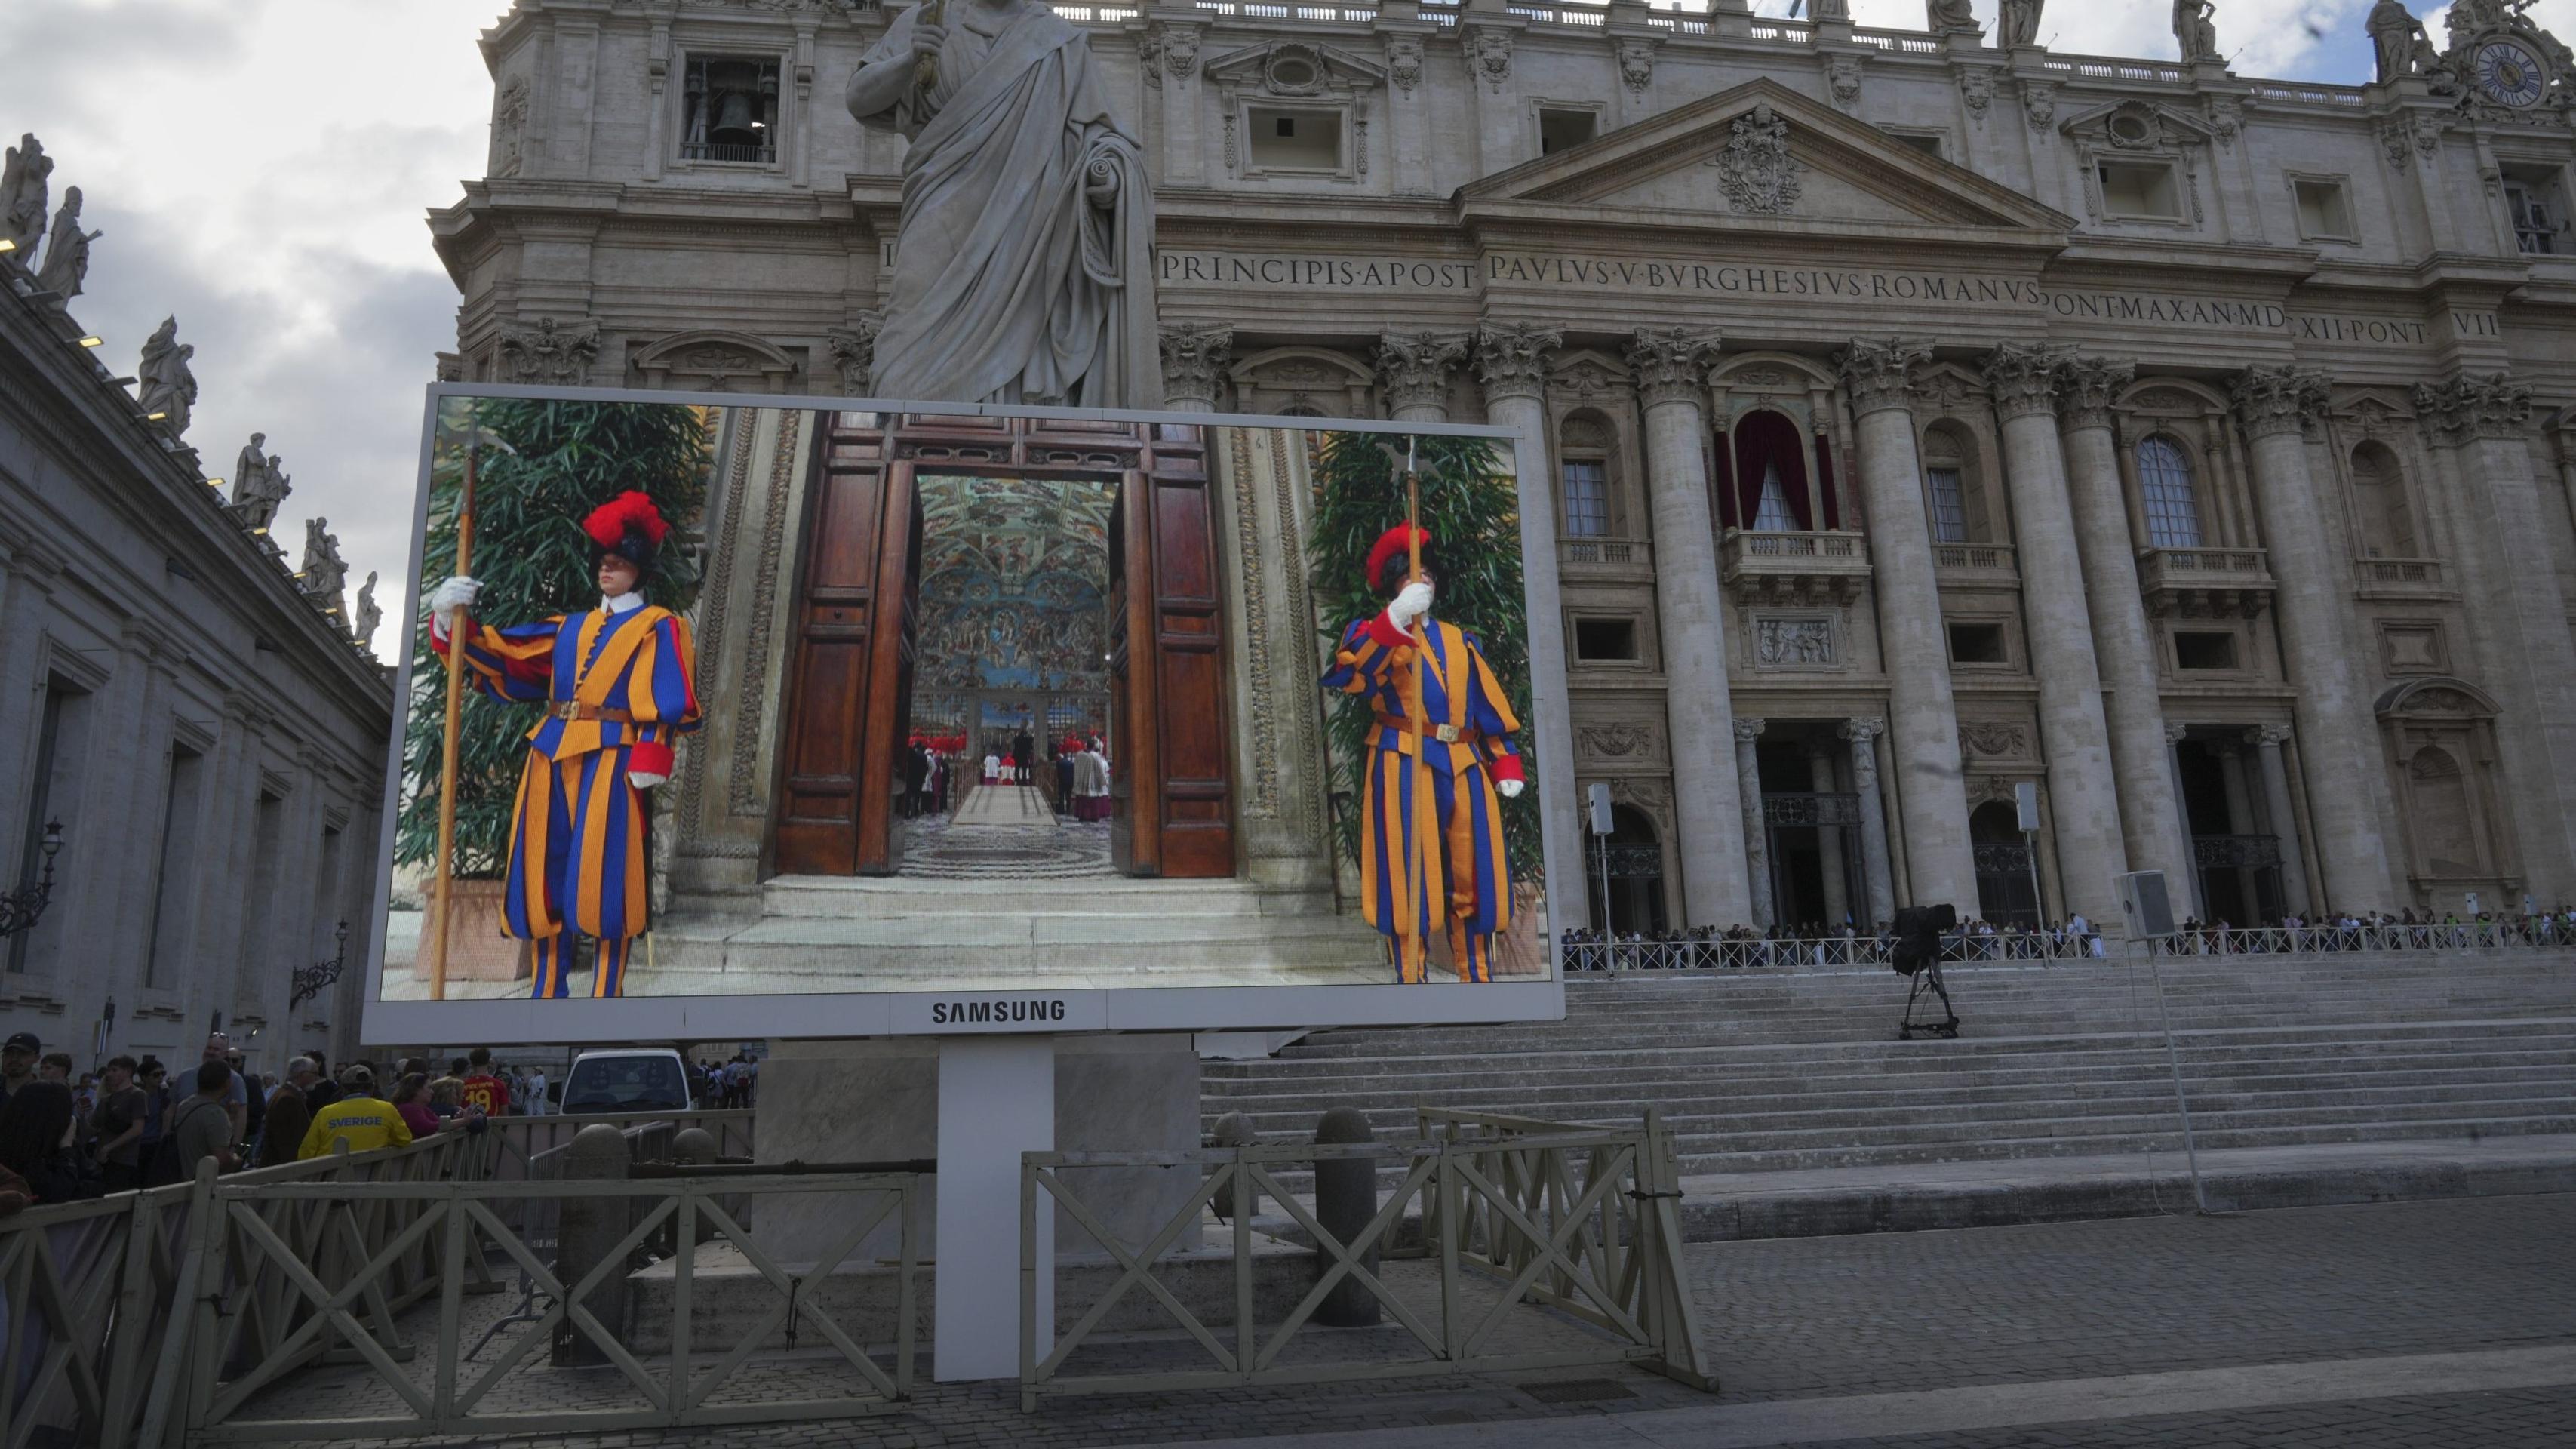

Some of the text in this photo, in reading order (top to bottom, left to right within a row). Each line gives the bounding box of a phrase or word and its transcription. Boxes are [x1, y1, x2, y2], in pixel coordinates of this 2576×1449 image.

[1161, 255, 1475, 288] PRINCIPIS APOST
[1489, 255, 2039, 304] PAVLVS V BVRGHESIVS ROMANVS
[2119, 296, 2187, 322] MAX
[2193, 301, 2232, 325] AN
[2350, 319, 2426, 344] PONT
[2454, 312, 2498, 336] VII
[933, 1000, 1065, 1023] SAMSUNG
[465, 1088, 491, 1112] 19
[328, 1116, 383, 1129] SVERIGE
